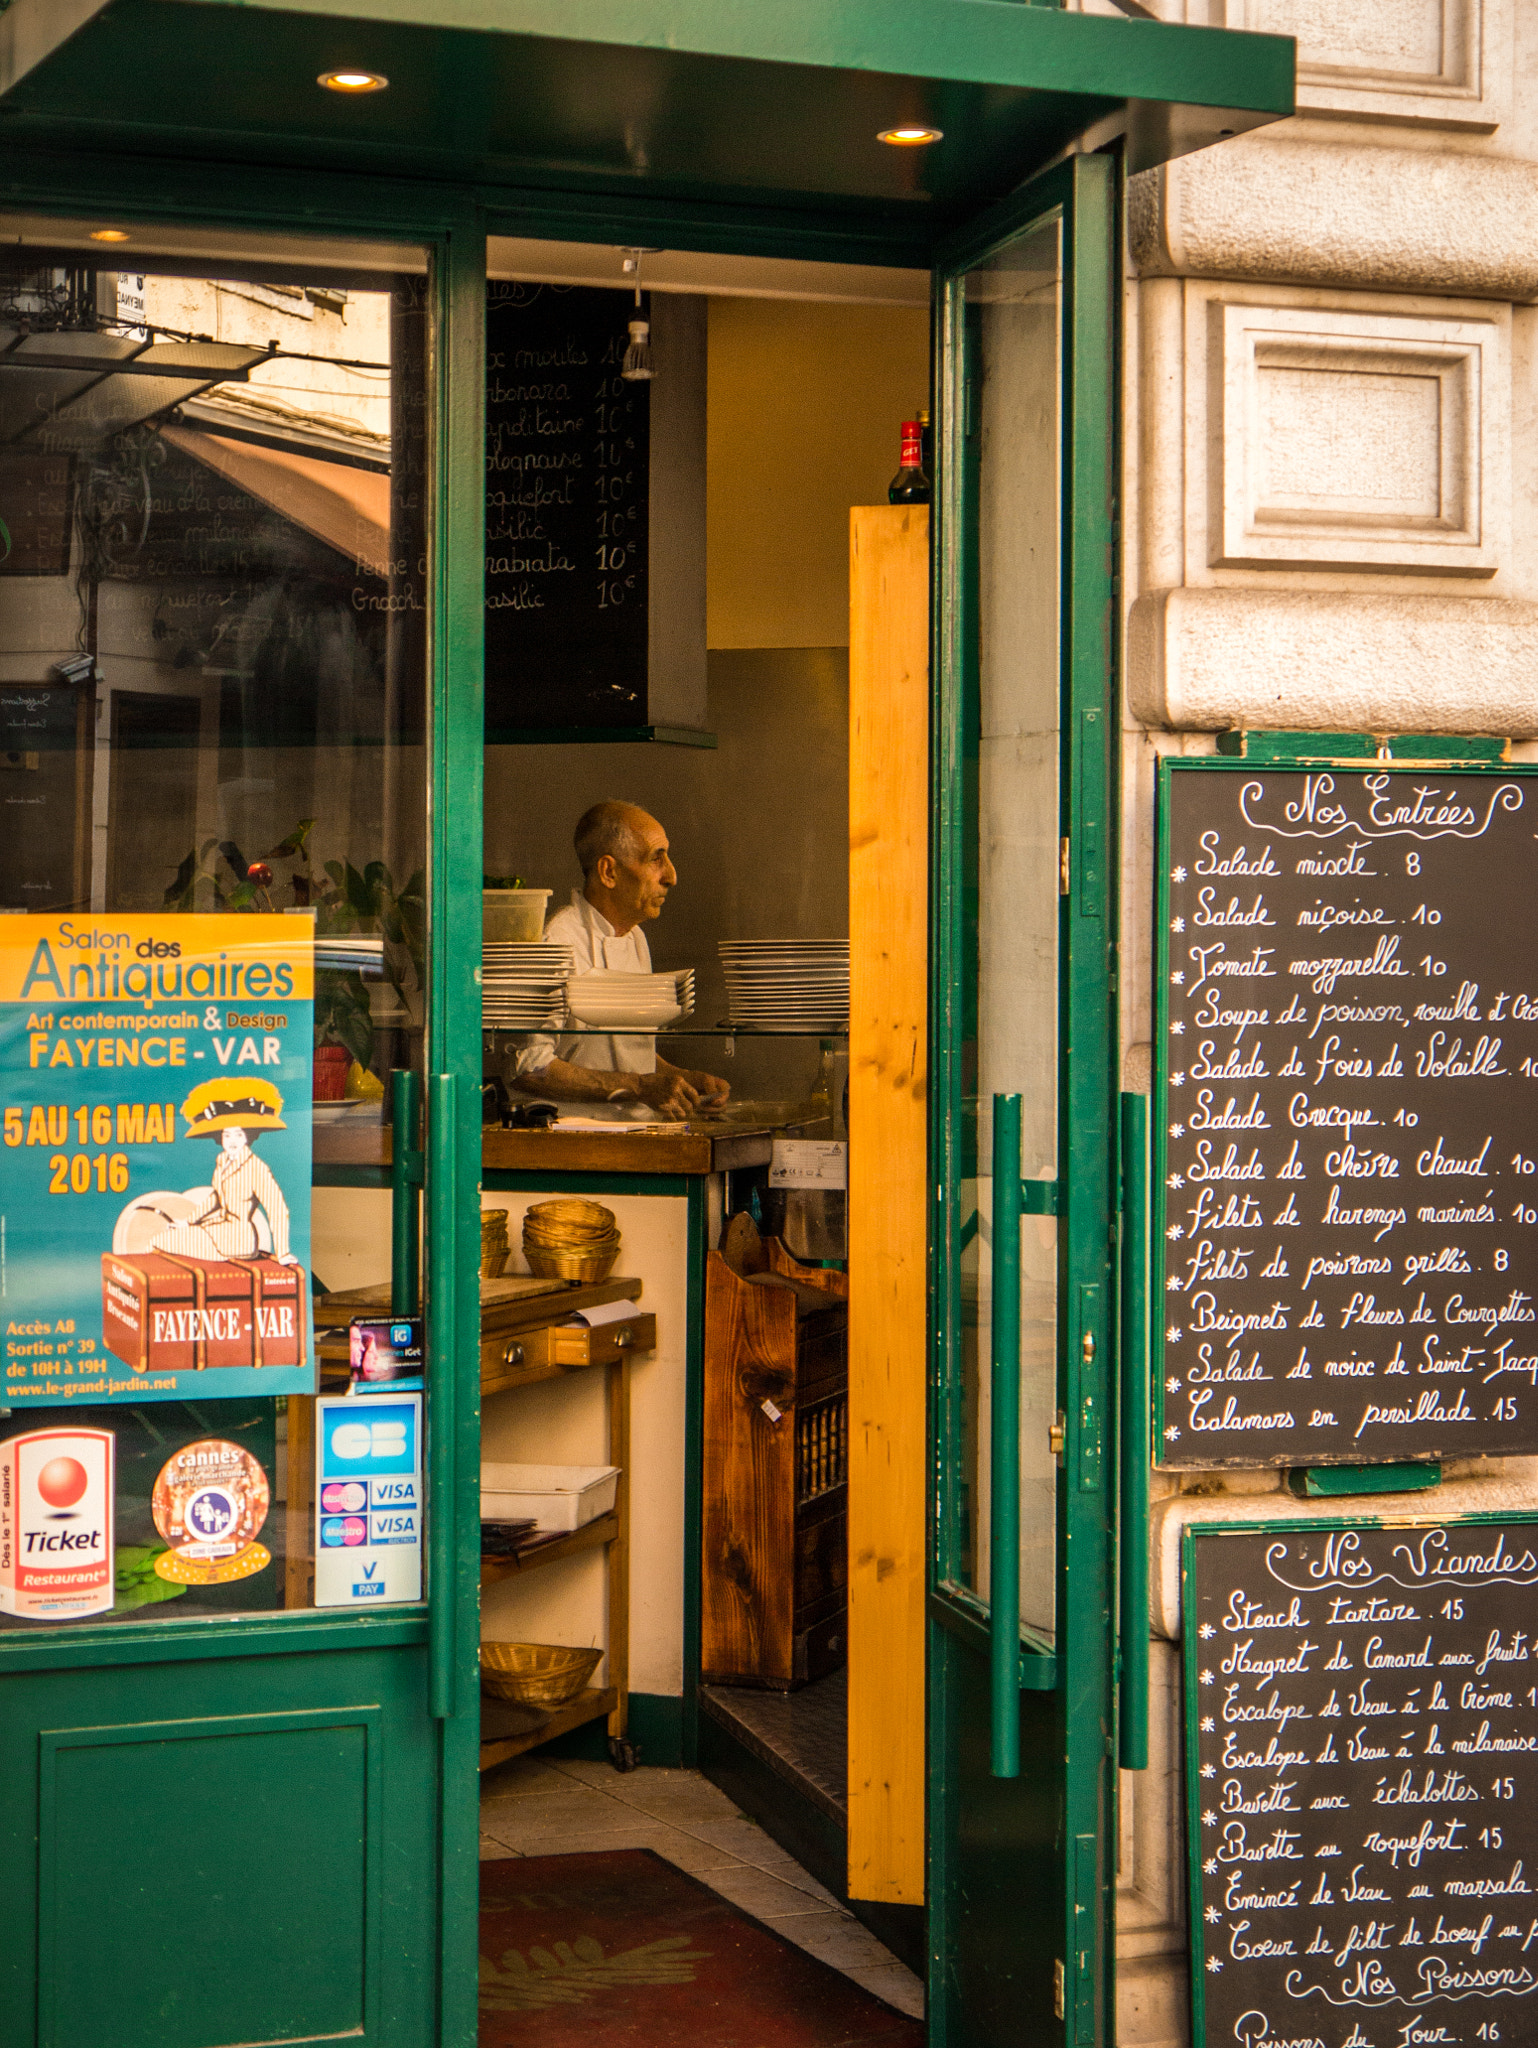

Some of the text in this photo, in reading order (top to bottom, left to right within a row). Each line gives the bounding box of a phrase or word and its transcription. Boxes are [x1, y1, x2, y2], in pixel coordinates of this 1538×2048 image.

[903, 446, 918, 456] GET
[1284, 773, 1475, 827] Nos Entrées
[1193, 830, 1282, 877] Salade
[1405, 851, 1421, 877] 8
[1192, 885, 1277, 927] Salade
[1411, 903, 1442, 925] 10
[59, 922, 181, 958] Salon des
[20, 938, 294, 1009] Antiquaires
[1186, 941, 1277, 998] Tomate
[1419, 954, 1447, 977] 10
[26, 1006, 287, 1032] Art contemporain & Design
[1194, 987, 1270, 1045] Soupe
[1274, 993, 1308, 1025] de
[1413, 980, 1482, 1022] rouille
[1488, 991, 1511, 1022] et
[29, 1033, 280, 1068] FAYENCE VAR
[1189, 1039, 1271, 1080] Salade
[1277, 1045, 1307, 1077] de
[1376, 1042, 1404, 1077] de
[26, 1106, 68, 1145] AU
[73, 1105, 112, 1145] 16
[117, 1103, 175, 1143] MAI
[1188, 1088, 1272, 1131] Salade
[1392, 1108, 1419, 1128] 10
[48, 1153, 129, 1193] 2016
[1186, 1138, 1266, 1182] Salade
[1275, 1139, 1307, 1180] de
[1511, 1153, 1536, 1175] 10
[1272, 1192, 1301, 1226] de
[1321, 1183, 1407, 1243] harengs
[1511, 1203, 1538, 1224] 10
[112, 1264, 134, 1288] Salon
[1259, 1245, 1290, 1278] de
[1301, 1251, 1392, 1291] poivrons
[1494, 1248, 1509, 1272] 8
[6, 1320, 51, 1336] Accès
[154, 1307, 293, 1342] FAYENCE VAR
[1188, 1290, 1292, 1349] Beignets
[1298, 1299, 1326, 1329] de
[1408, 1291, 1437, 1324] de
[1444, 1289, 1536, 1337] Courgettes
[6, 1342, 53, 1357] Sortie
[78, 1339, 95, 1353] 39
[6, 1358, 106, 1377] de 10H à 19H
[1187, 1342, 1274, 1383] Salade
[1285, 1346, 1313, 1379] de
[1383, 1340, 1410, 1375] de
[6, 1376, 176, 1398] www.le-grand-jardin.net
[1188, 1387, 1295, 1432] Calamars
[1307, 1409, 1339, 1427] en
[1491, 1396, 1517, 1422] 15
[177, 1450, 239, 1467] cannes
[377, 1484, 414, 1499] VISA
[24, 1530, 101, 1552] Ticket
[377, 1518, 414, 1533] VISA
[1308, 1528, 1537, 1579] Nos Viandes
[359, 1585, 378, 1594] PAY
[1221, 1589, 1311, 1632] Steack
[1440, 1598, 1464, 1620] 15
[1221, 1629, 1529, 1691] Magret de Canard aux fruits
[1222, 1682, 1313, 1734] Escalope
[1318, 1688, 1342, 1718] de
[1348, 1678, 1397, 1717] Veau
[1427, 1680, 1450, 1711] la
[1221, 1730, 1311, 1777] Escalope
[1315, 1733, 1340, 1764] de
[1346, 1725, 1391, 1762] Veau
[1423, 1723, 1446, 1755] la
[1451, 1719, 1538, 1754] milanaise
[1219, 1778, 1302, 1814] Bavette
[1309, 1795, 1351, 1810] aux
[1491, 1777, 1515, 1800] 15
[1216, 1820, 1304, 1863] Bavette
[1314, 1844, 1343, 1858] au
[1478, 1827, 1503, 1850] 15
[1224, 1869, 1302, 1911] Emincé
[1308, 1871, 1335, 1905] de
[1340, 1863, 1392, 1903] Veau
[1406, 1884, 1434, 1898] au
[1228, 1914, 1523, 1968] Coeur de filet de boeuf au
[1341, 1957, 1533, 2000] Nos Poissons
[1341, 2023, 1376, 2048] du
[1475, 2022, 1500, 2041] 16
